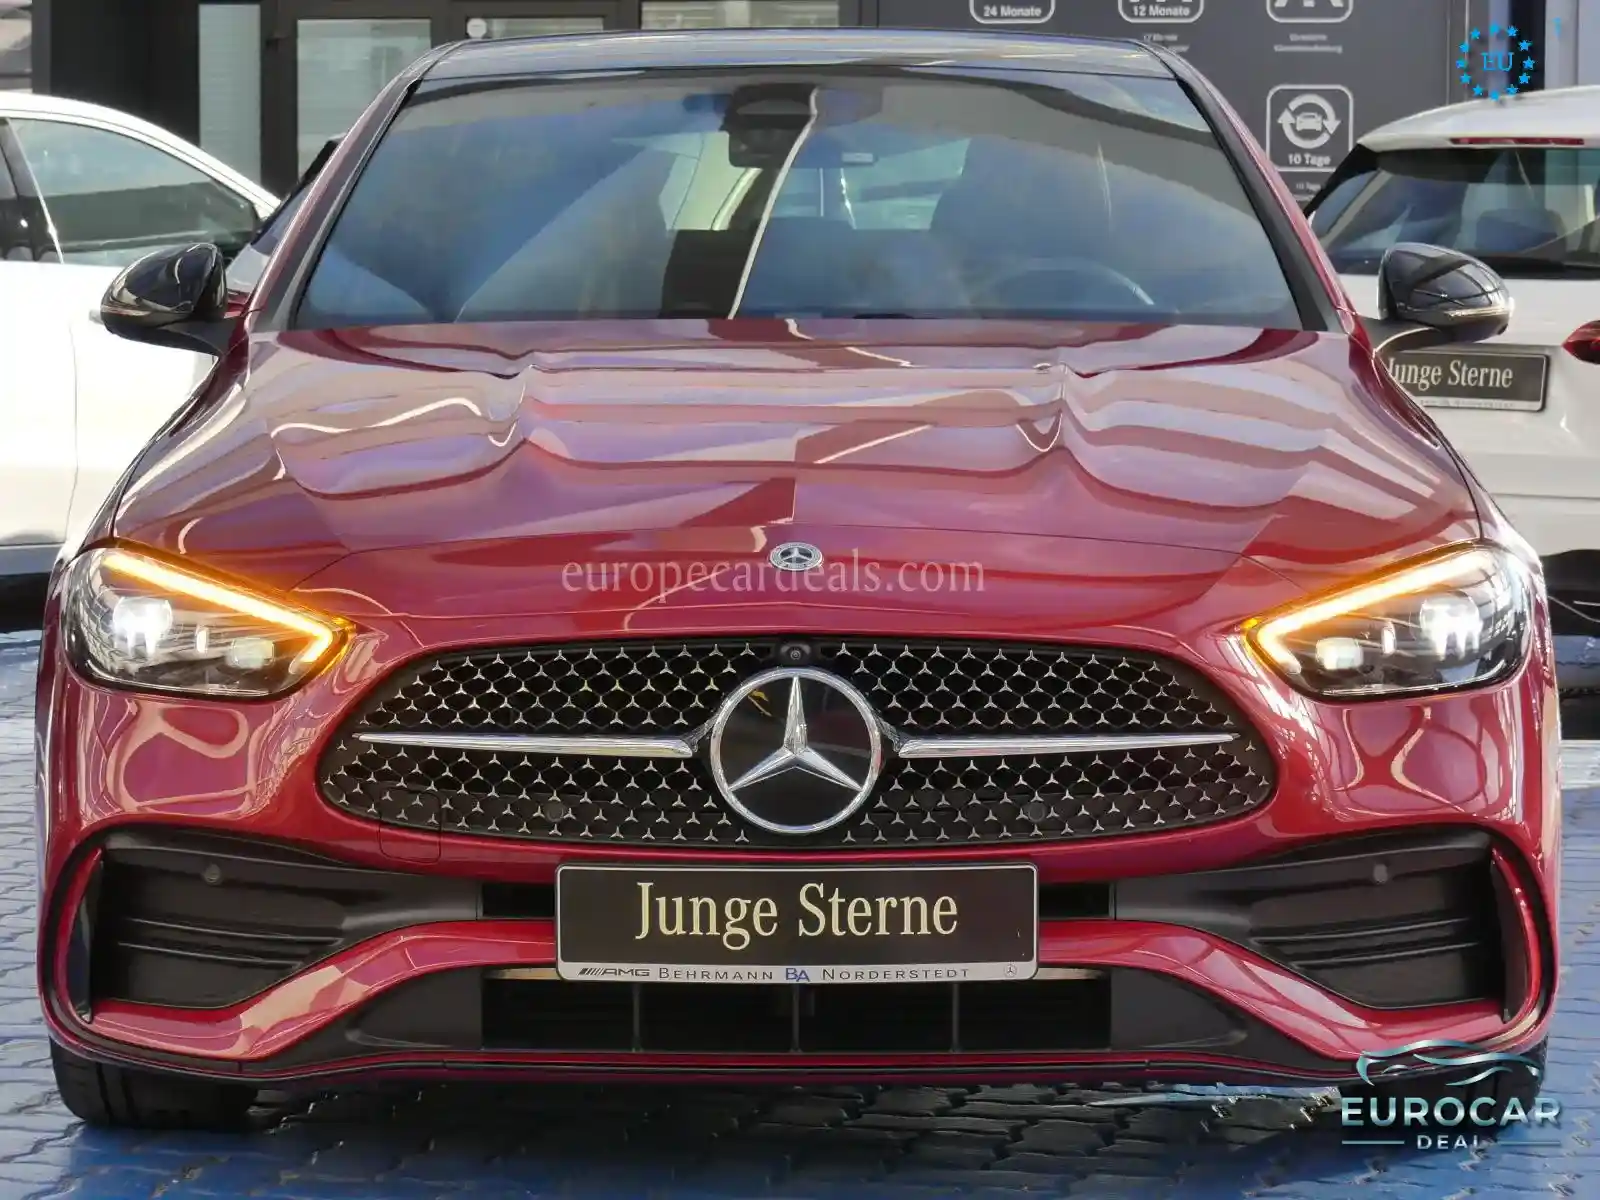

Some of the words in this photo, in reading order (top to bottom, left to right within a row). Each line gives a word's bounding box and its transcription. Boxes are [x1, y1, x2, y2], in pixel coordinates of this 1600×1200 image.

[984, 6, 998, 17] 24
[1000, 6, 1042, 17] Monate
[1133, 6, 1147, 17] 12
[1149, 5, 1190, 17] Monate
[1288, 153, 1302, 165] 10
[1304, 153, 1331, 167] Tage
[1448, 360, 1513, 388] Sterne
[635, 882, 778, 950] Junge
[798, 882, 957, 937] Sterne
[601, 968, 650, 977] AMG
[785, 967, 811, 982] BA
